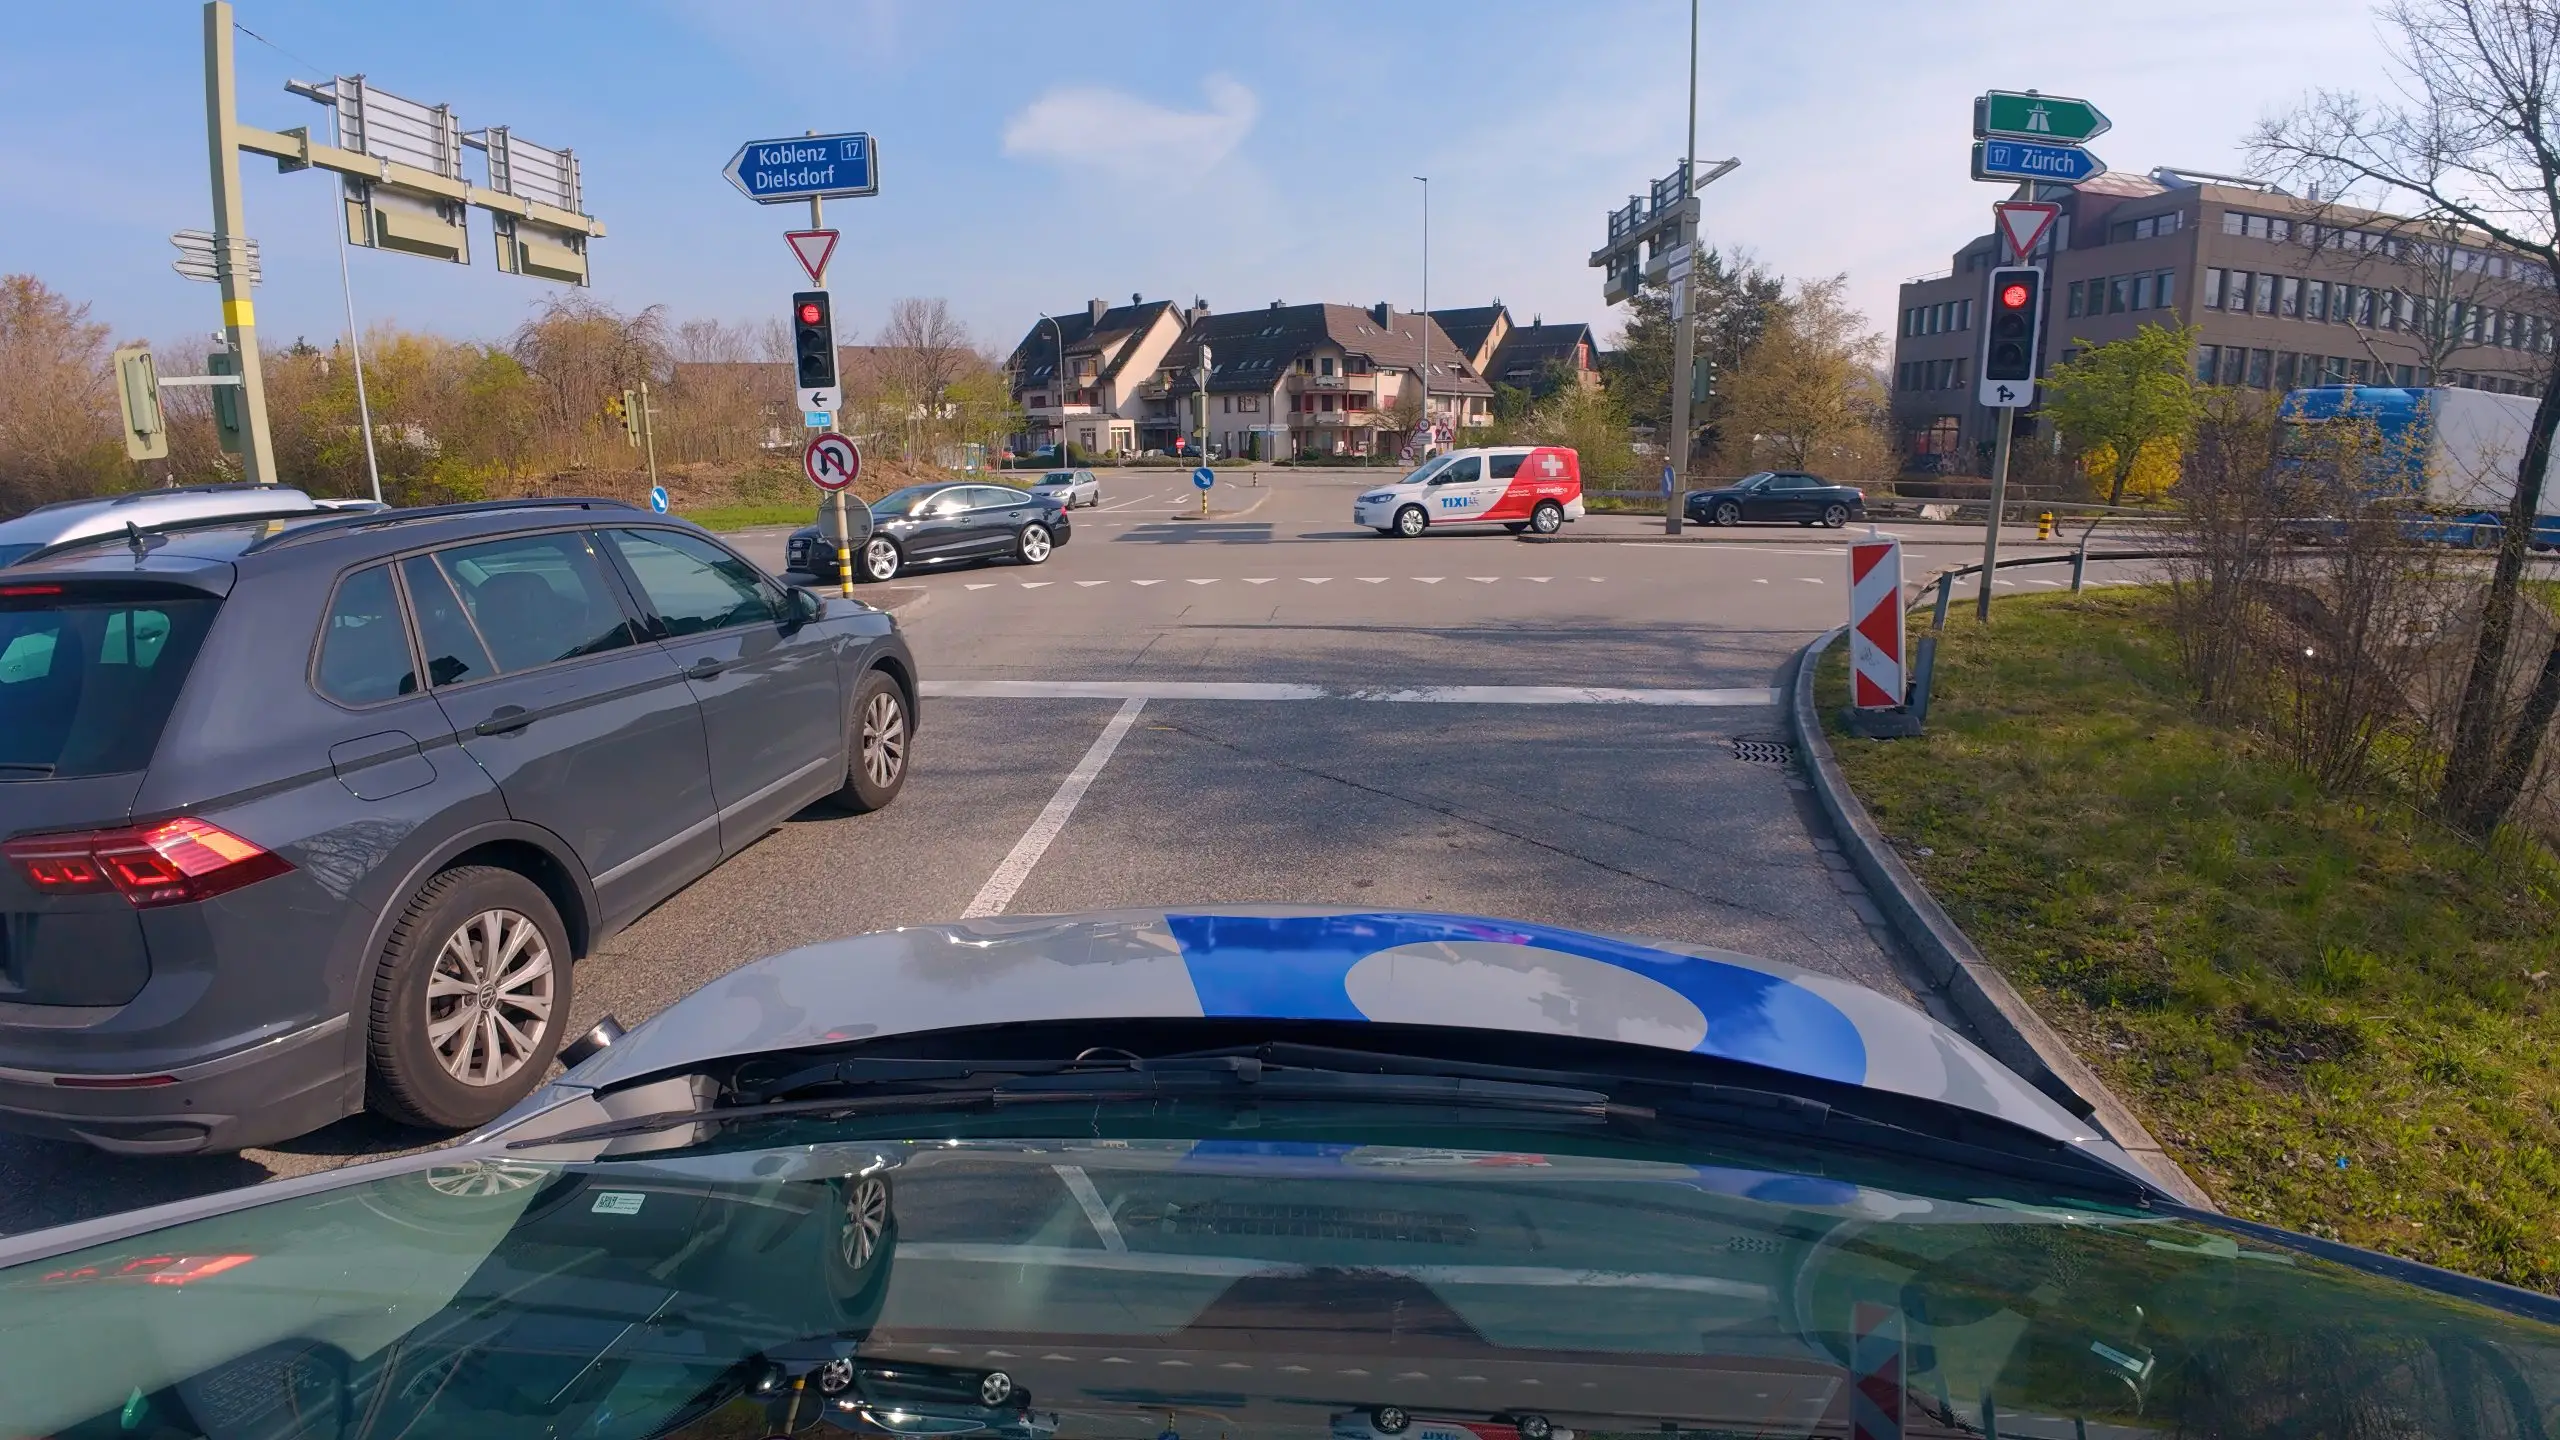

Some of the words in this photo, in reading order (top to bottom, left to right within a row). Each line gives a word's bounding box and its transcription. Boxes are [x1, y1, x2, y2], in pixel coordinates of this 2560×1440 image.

[759, 145, 827, 166] Koblenz
[845, 143, 859, 157] 17
[1994, 149, 2006, 163] 17
[2021, 149, 2074, 173] Zürich
[756, 164, 835, 189] Dielsdorf
[1441, 497, 1468, 508] TIXI
